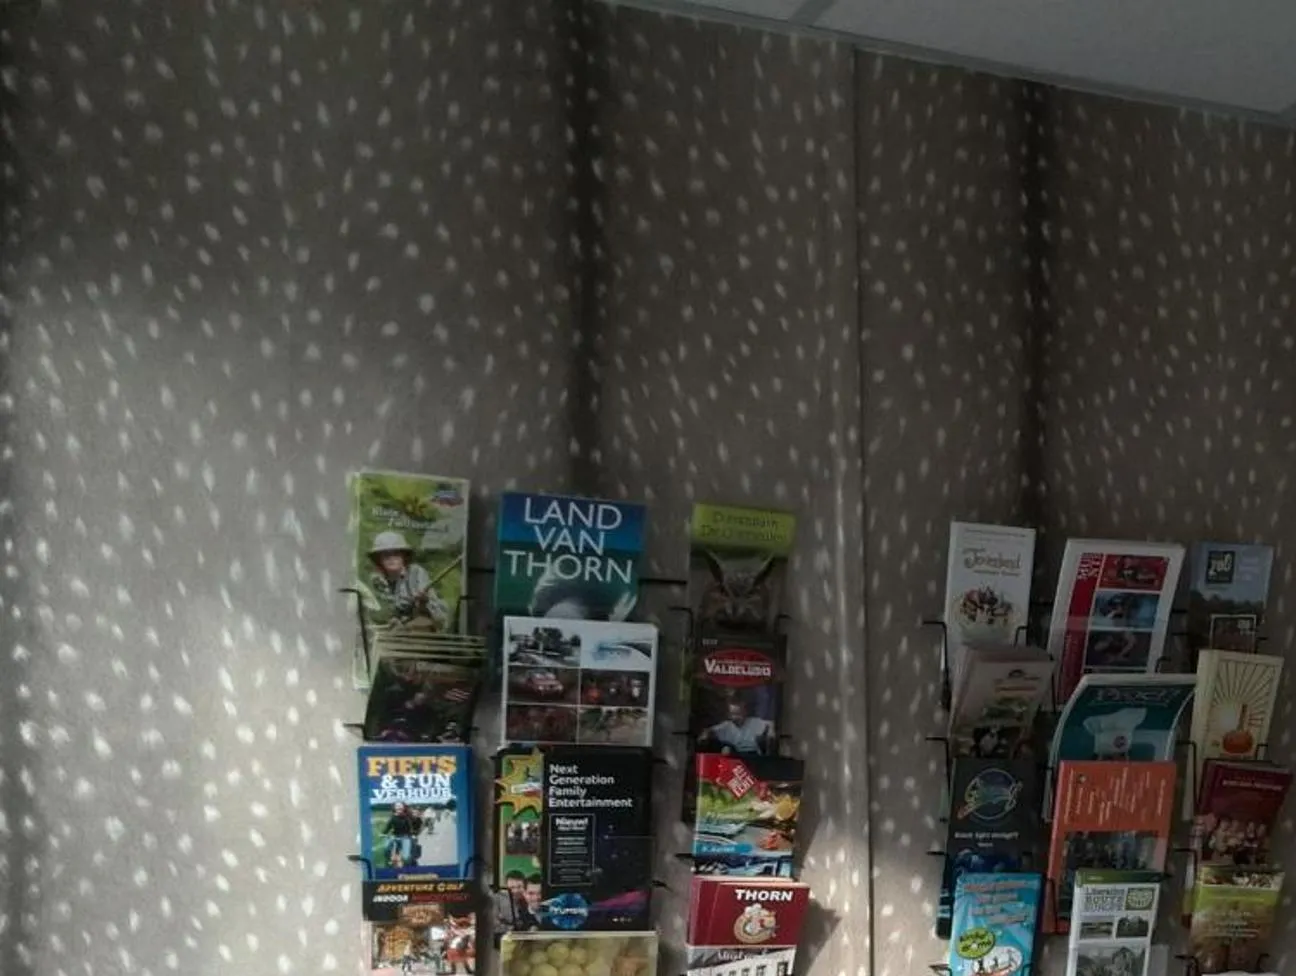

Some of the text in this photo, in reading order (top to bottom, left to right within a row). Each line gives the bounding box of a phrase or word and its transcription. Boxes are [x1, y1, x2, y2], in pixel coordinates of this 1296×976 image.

[524, 497, 623, 530] LAND
[533, 525, 605, 556] VAN
[503, 550, 633, 584] THORN
[367, 756, 457, 777] FIETS
[550, 764, 579, 775] Next
[380, 773, 450, 789] & FUN
[550, 775, 615, 785] Generation
[372, 788, 456, 800] VERHUUR
[549, 786, 587, 797] Family
[549, 797, 633, 808] Entertainment
[734, 889, 794, 901] THORN
